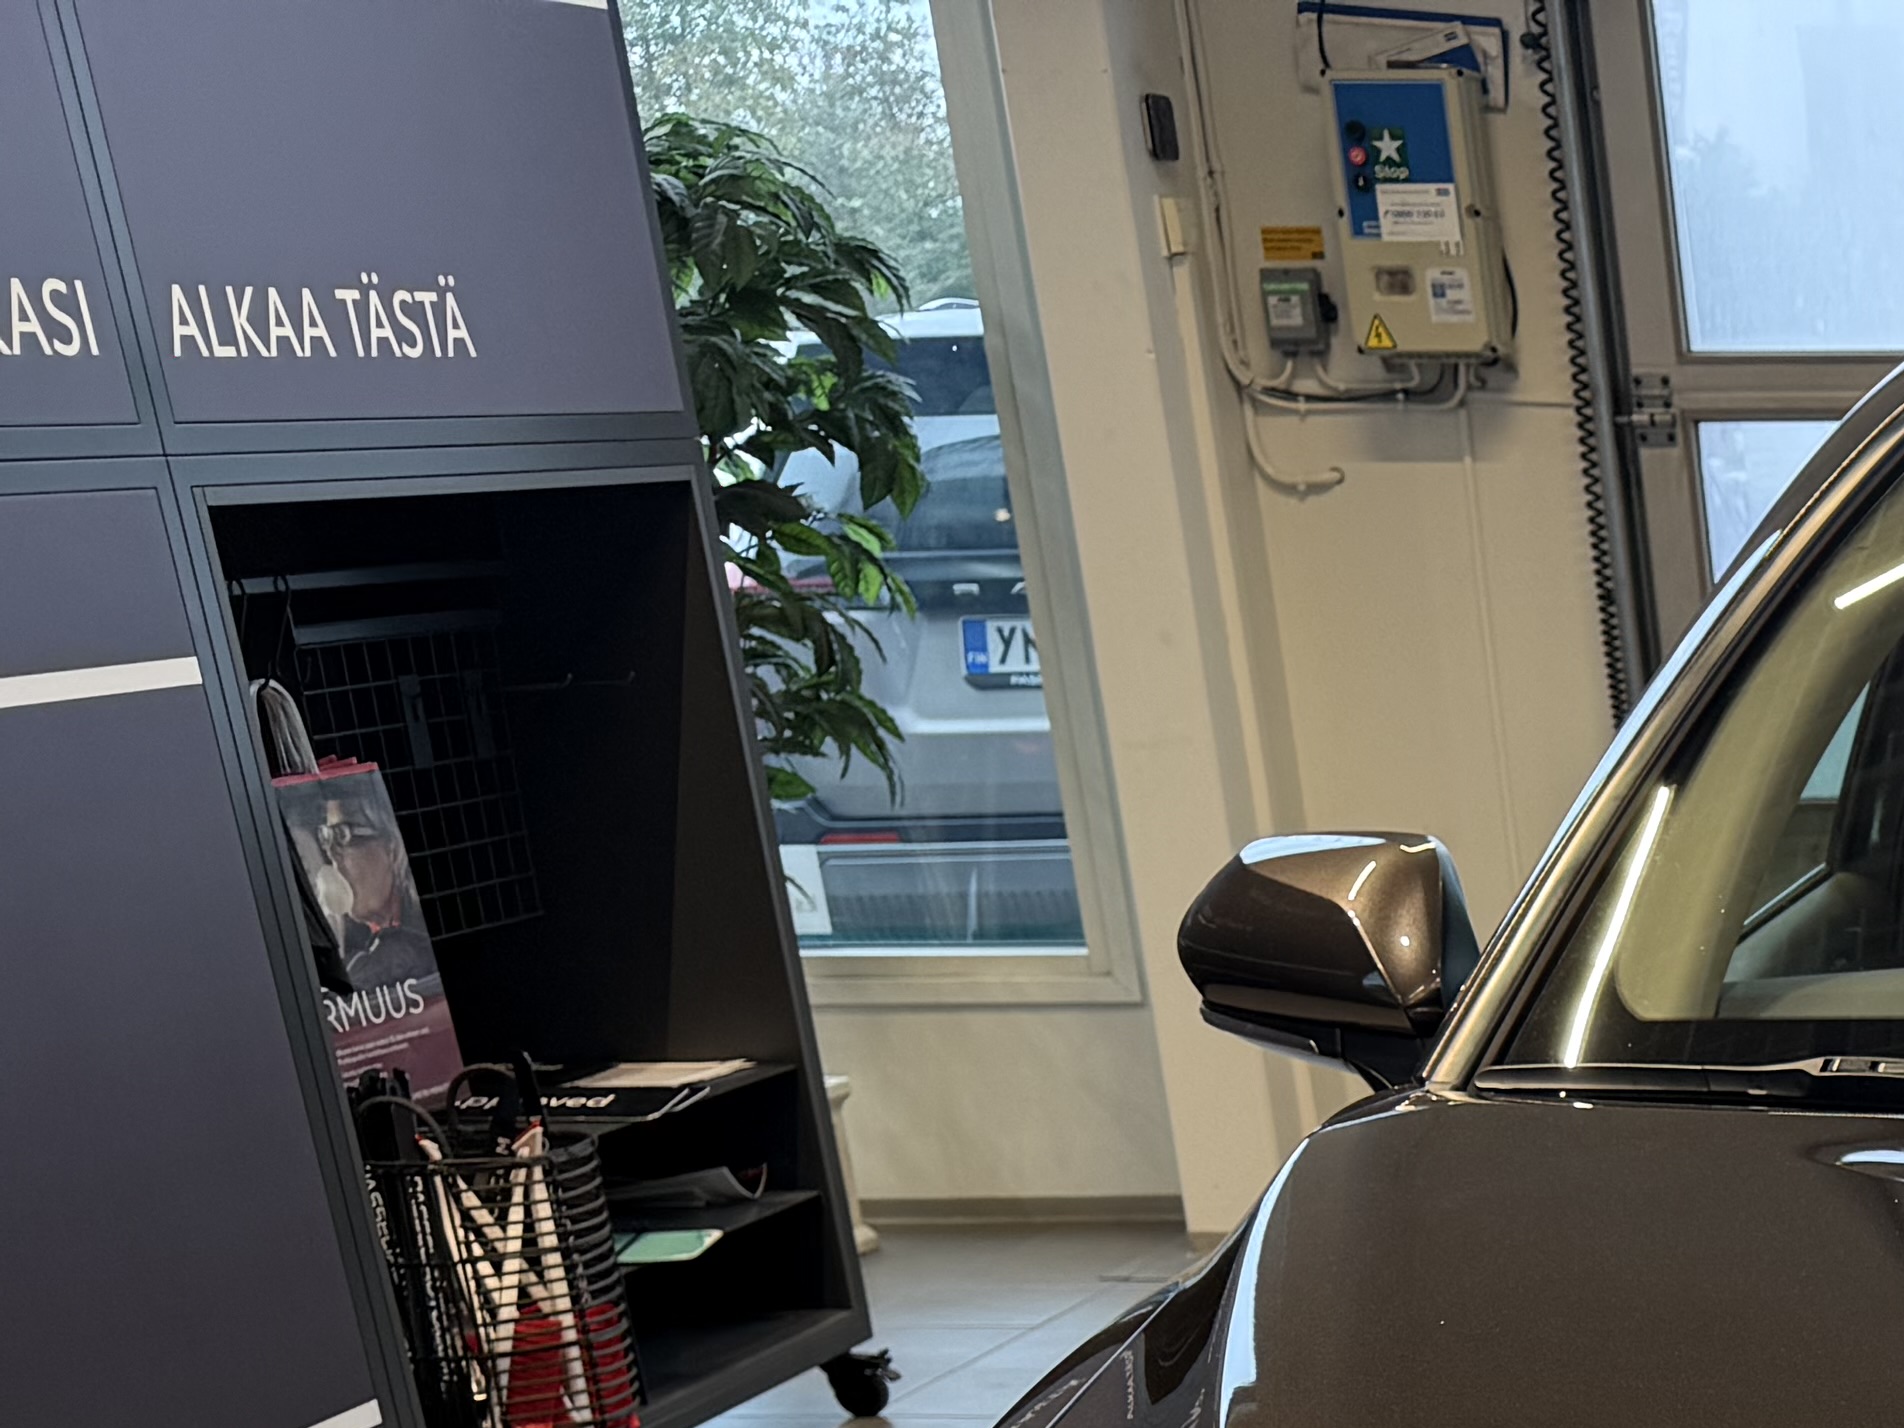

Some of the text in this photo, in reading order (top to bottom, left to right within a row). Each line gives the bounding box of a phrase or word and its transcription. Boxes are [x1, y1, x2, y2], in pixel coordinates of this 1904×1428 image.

[0, 271, 478, 359] ASI ALKAA TÄSTÄ
